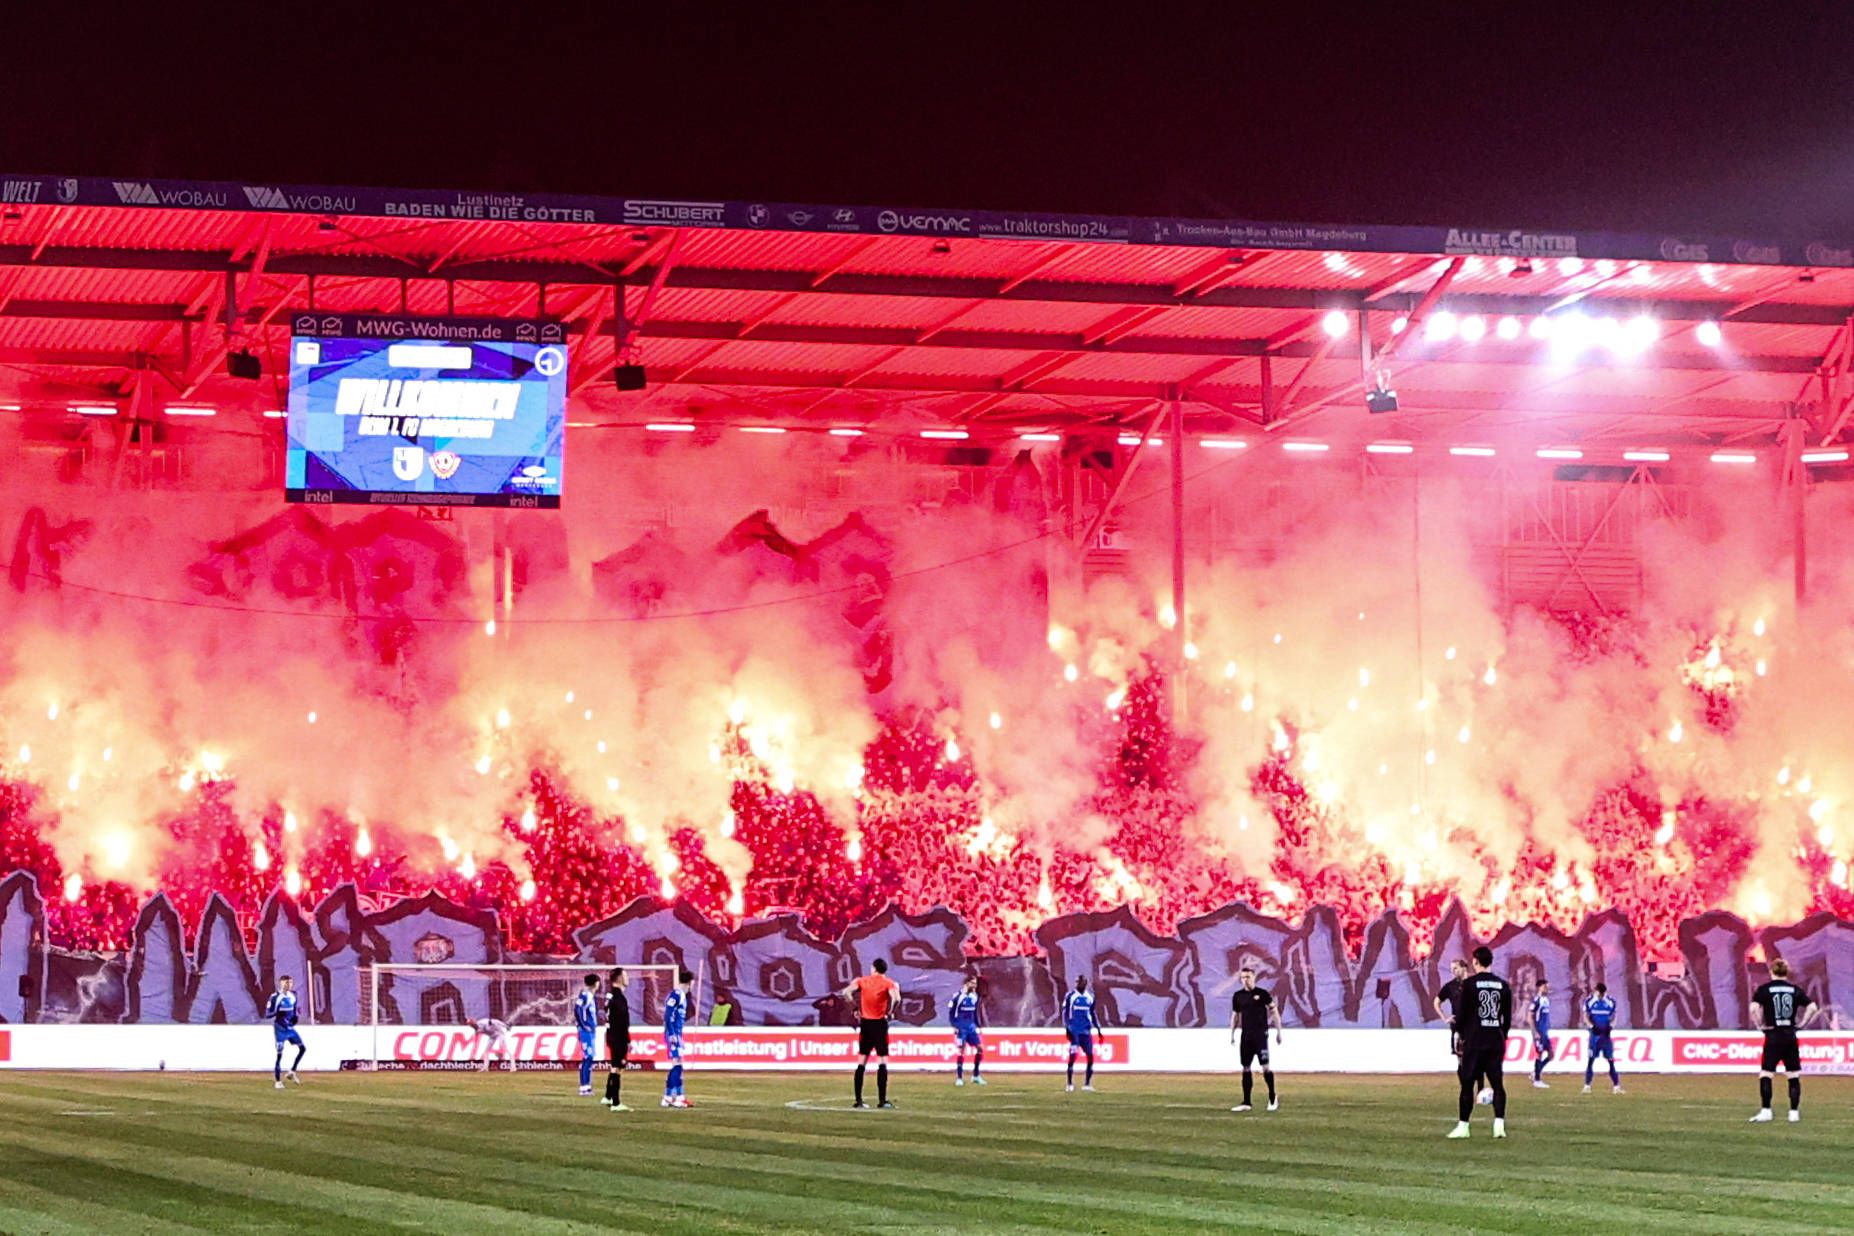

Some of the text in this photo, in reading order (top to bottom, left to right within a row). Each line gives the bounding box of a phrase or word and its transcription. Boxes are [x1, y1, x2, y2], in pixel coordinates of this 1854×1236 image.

[3, 181, 42, 203] WELT
[161, 190, 227, 206] WOBAU
[289, 195, 356, 211] WOBAU
[624, 202, 724, 220] SCHUBERT
[384, 203, 595, 222] BADEN WIE DIE GÖTTER
[356, 319, 502, 339] MWG-Wohnen.de
[304, 490, 334, 503] intel
[510, 494, 538, 508] intel
[1772, 993, 1793, 1019] 18
[801, 1039, 852, 1056] Unser
[999, 1041, 1021, 1056] Ihr
[1025, 1041, 1113, 1061] Vorspng
